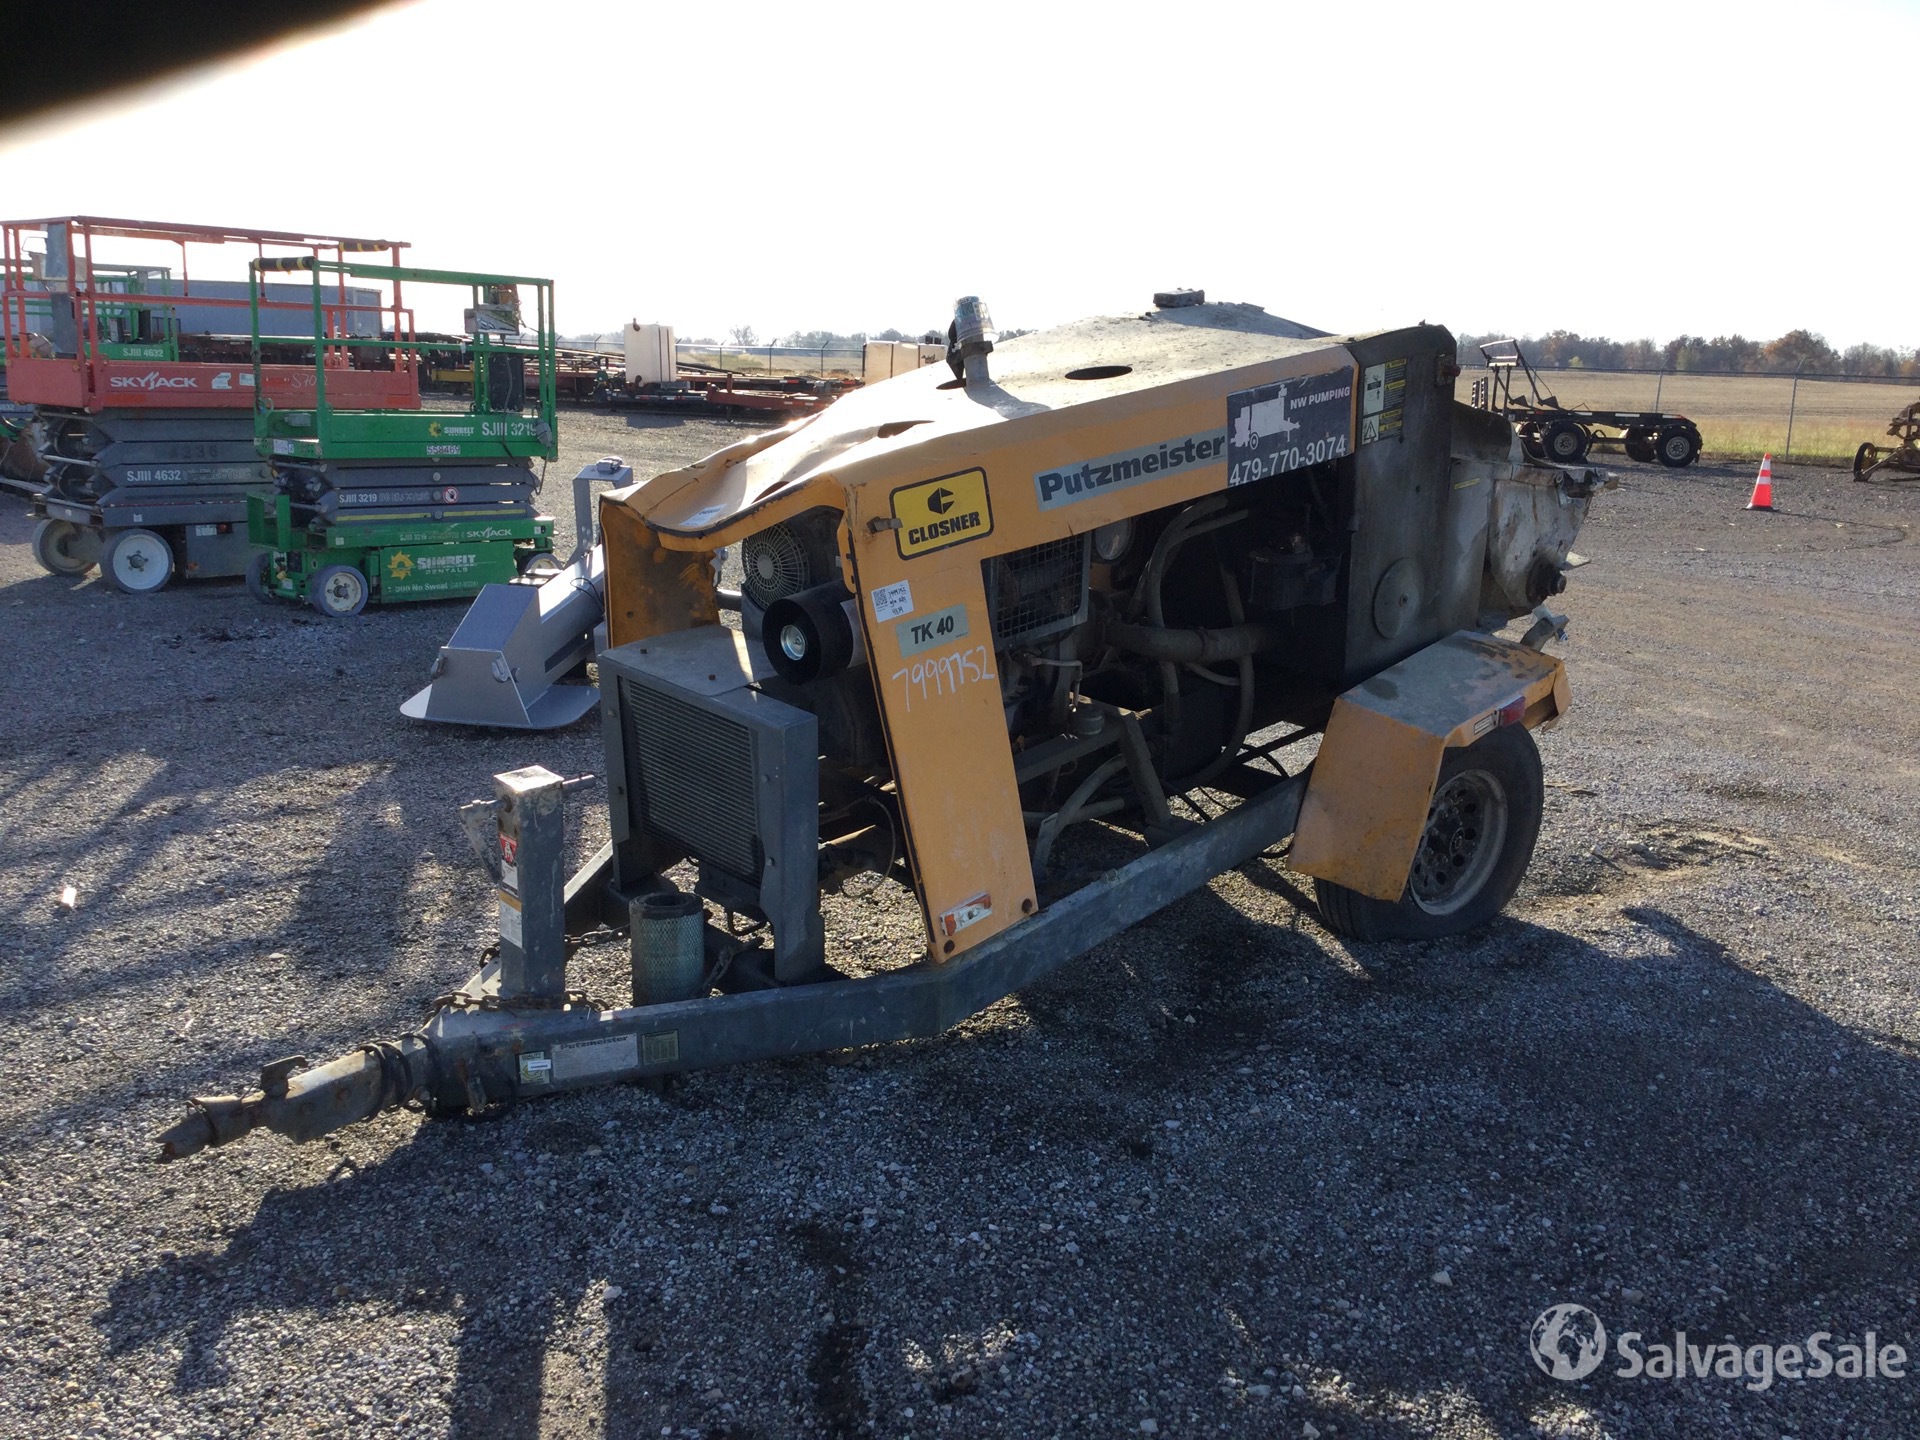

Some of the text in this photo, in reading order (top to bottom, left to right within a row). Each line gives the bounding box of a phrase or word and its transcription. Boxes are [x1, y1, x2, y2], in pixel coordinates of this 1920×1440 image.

[122, 347, 164, 357] SJIII 4632
[110, 371, 198, 390] SKYJACK
[1290, 386, 1351, 410] NW PUMPING
[443, 426, 474, 434] SUNBELT
[482, 422, 508, 436] SJIII
[1038, 434, 1226, 502] Putzmeister
[1229, 434, 1346, 487] 479-770-3074
[126, 470, 151, 482] SJIII
[154, 470, 181, 481] 4632
[339, 494, 357, 503] SJIII
[358, 493, 378, 502] 3219
[466, 526, 512, 538] SKYJACK
[908, 511, 981, 545] CLOSNER
[411, 584, 423, 592] No
[424, 582, 448, 591] Sweat
[910, 615, 954, 645] TK 40
[892, 645, 995, 713] 7999752
[560, 1035, 628, 1050] Putzmeister
